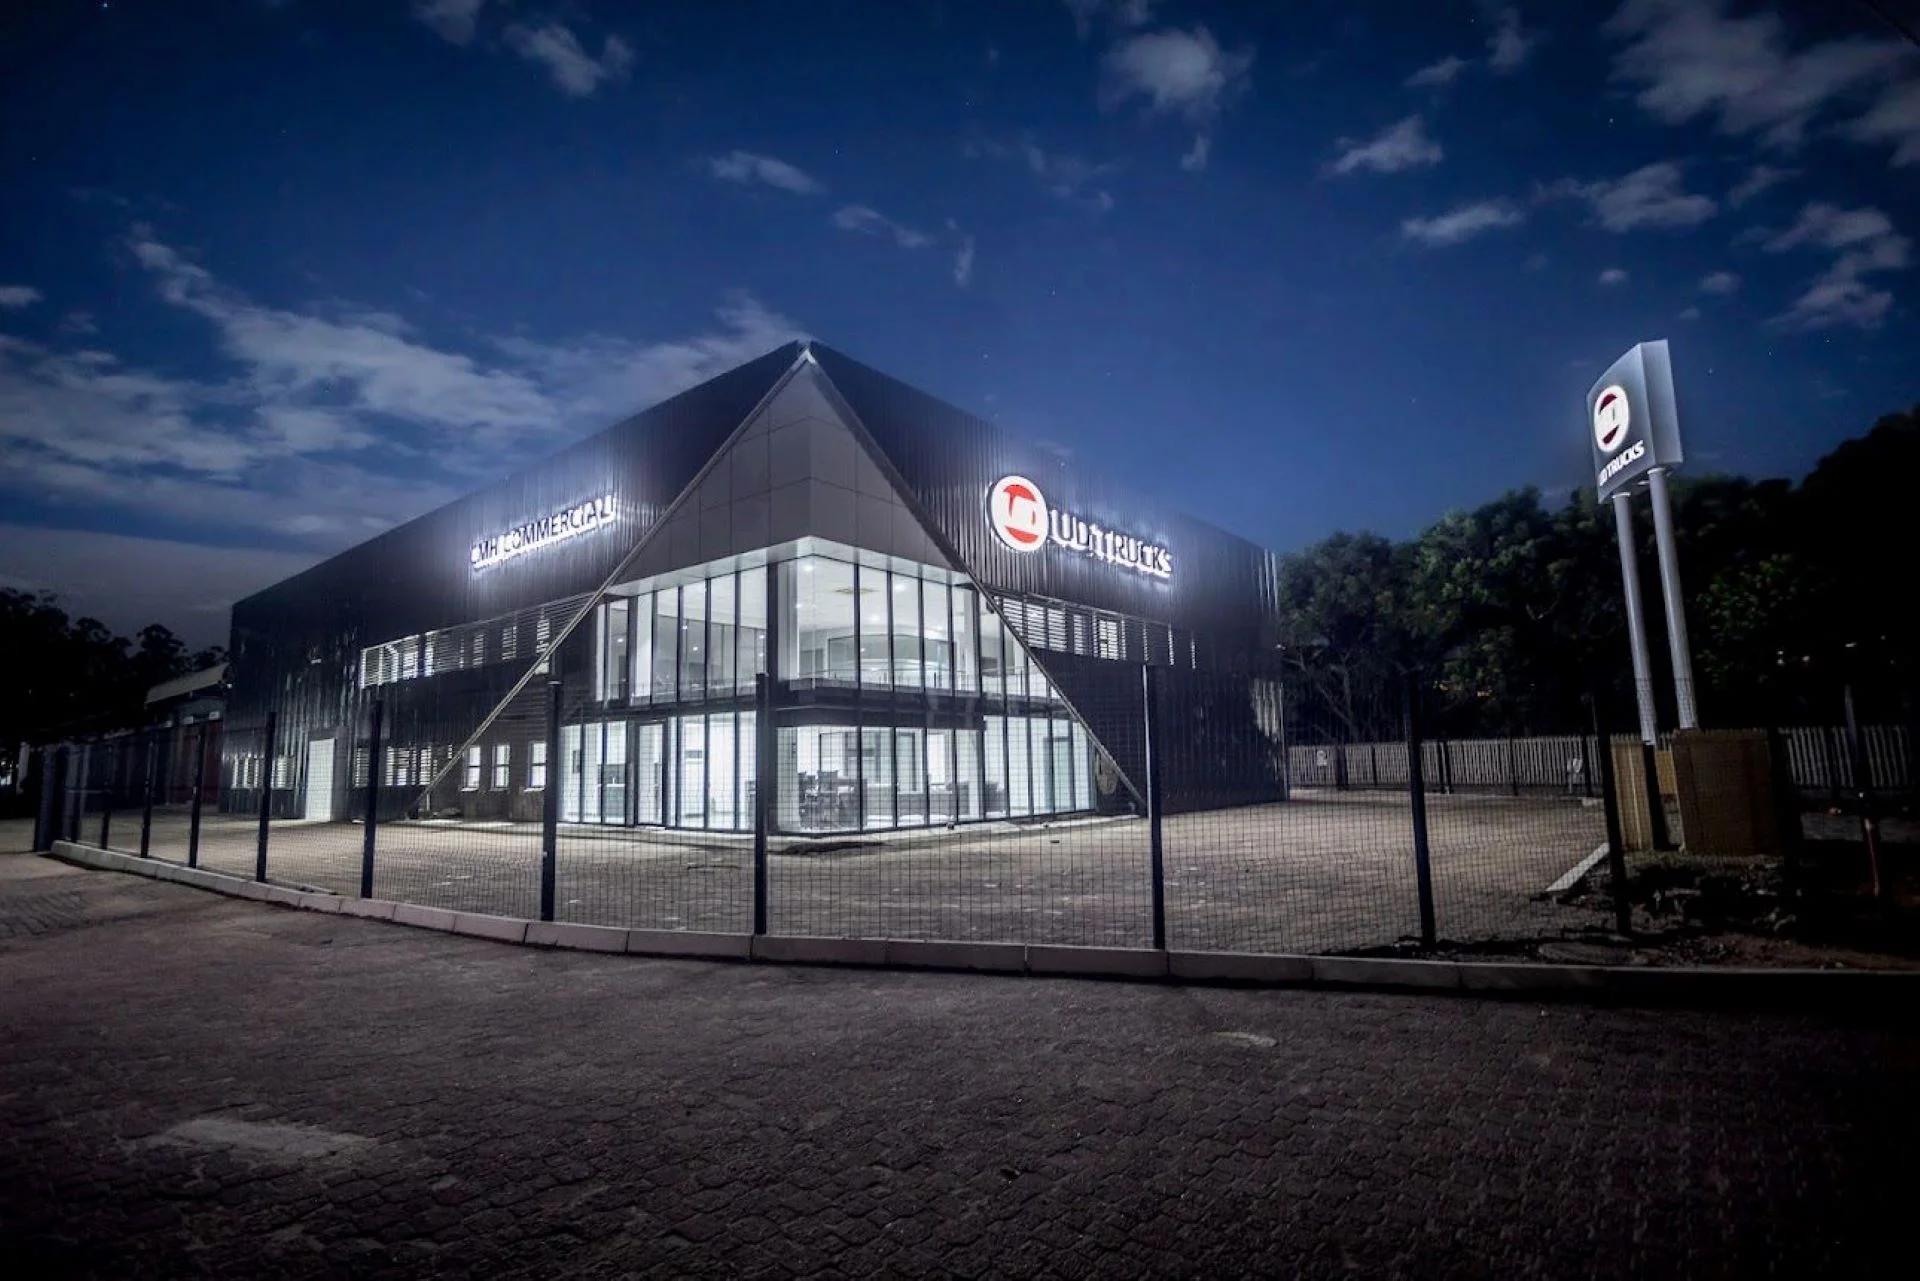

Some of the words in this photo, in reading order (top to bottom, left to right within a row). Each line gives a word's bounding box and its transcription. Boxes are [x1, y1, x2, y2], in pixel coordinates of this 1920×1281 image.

[1605, 440, 1644, 477] TRUCKS
[502, 494, 617, 556] COMMERCIAL
[1094, 523, 1174, 578] TRUCKS
